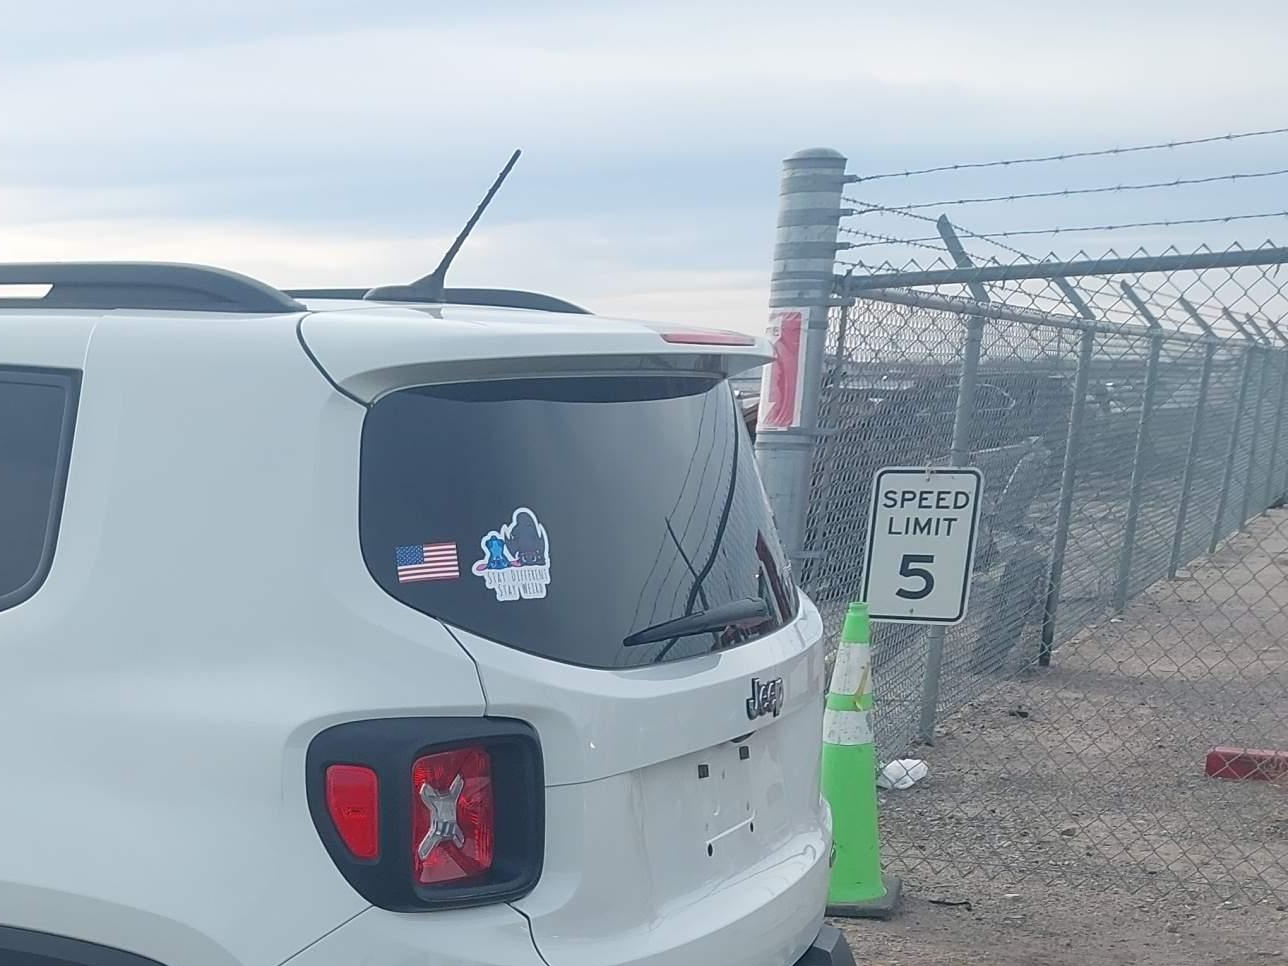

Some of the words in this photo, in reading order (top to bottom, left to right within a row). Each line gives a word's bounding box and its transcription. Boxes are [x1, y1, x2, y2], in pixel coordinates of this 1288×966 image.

[882, 490, 970, 509] SPEED
[888, 516, 958, 537] LIMIT
[895, 554, 935, 600] 5
[746, 677, 783, 720] Jeep
